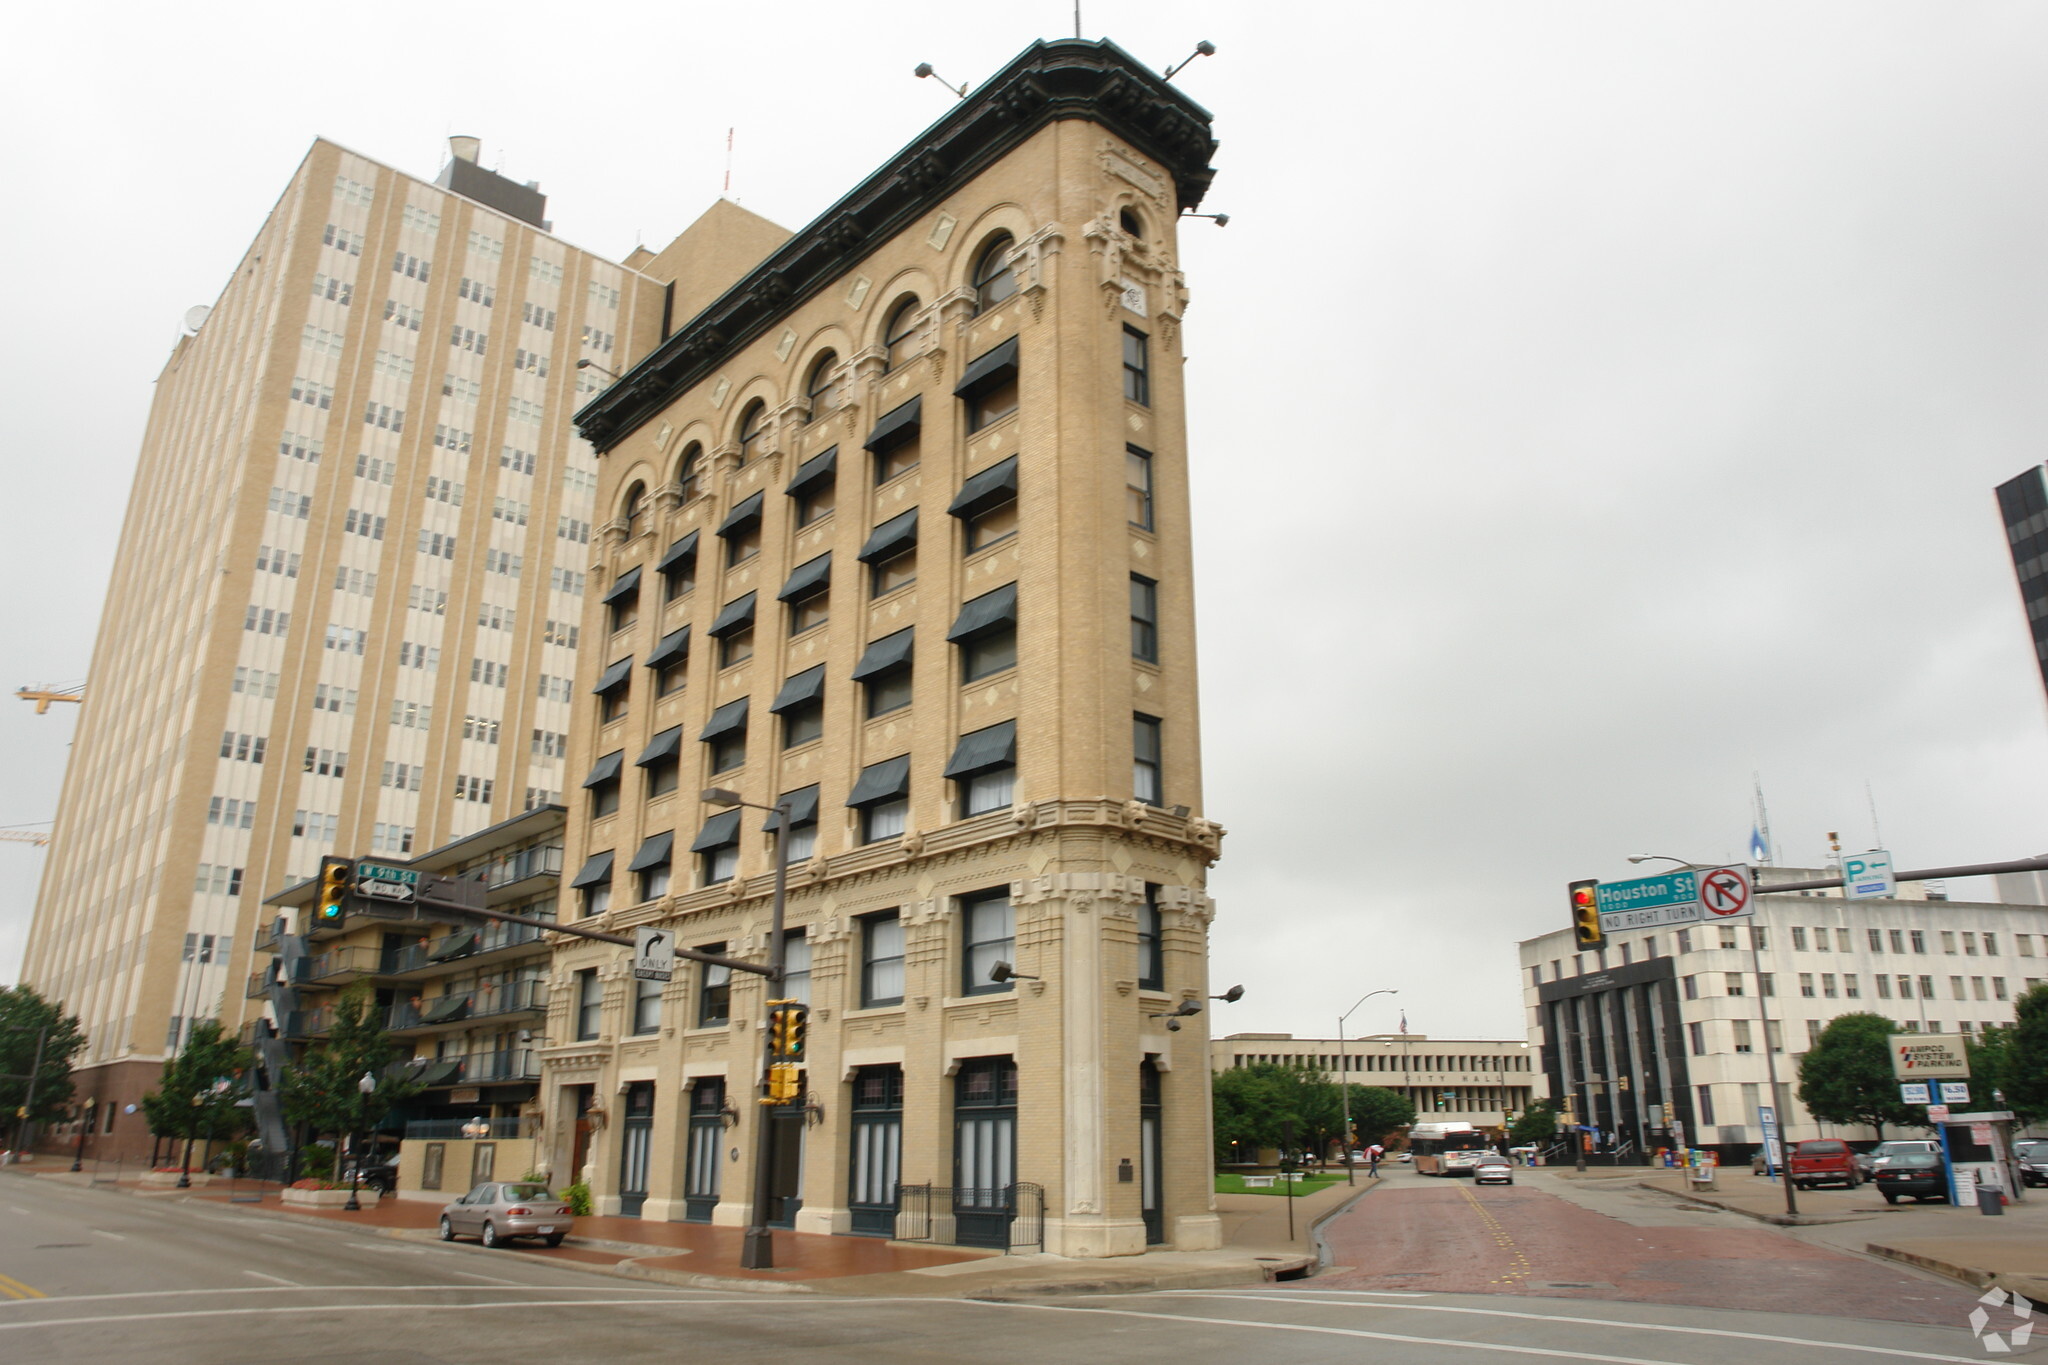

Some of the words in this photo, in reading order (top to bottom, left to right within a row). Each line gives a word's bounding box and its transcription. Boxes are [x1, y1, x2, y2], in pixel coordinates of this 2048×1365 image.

[377, 867, 397, 880] 9th
[1600, 883, 1668, 903] Houston
[1674, 877, 1694, 893] St
[1605, 917, 1621, 928] NO
[1627, 911, 1660, 925] RIGHT
[1666, 906, 1697, 920] TURN
[641, 957, 668, 970] ONLY
[1913, 1052, 1955, 1061] SYSTEM
[1917, 1059, 1963, 1068] PARKING
[1405, 1075, 1446, 1083] CITY
[1462, 1075, 1502, 1083] HALL
